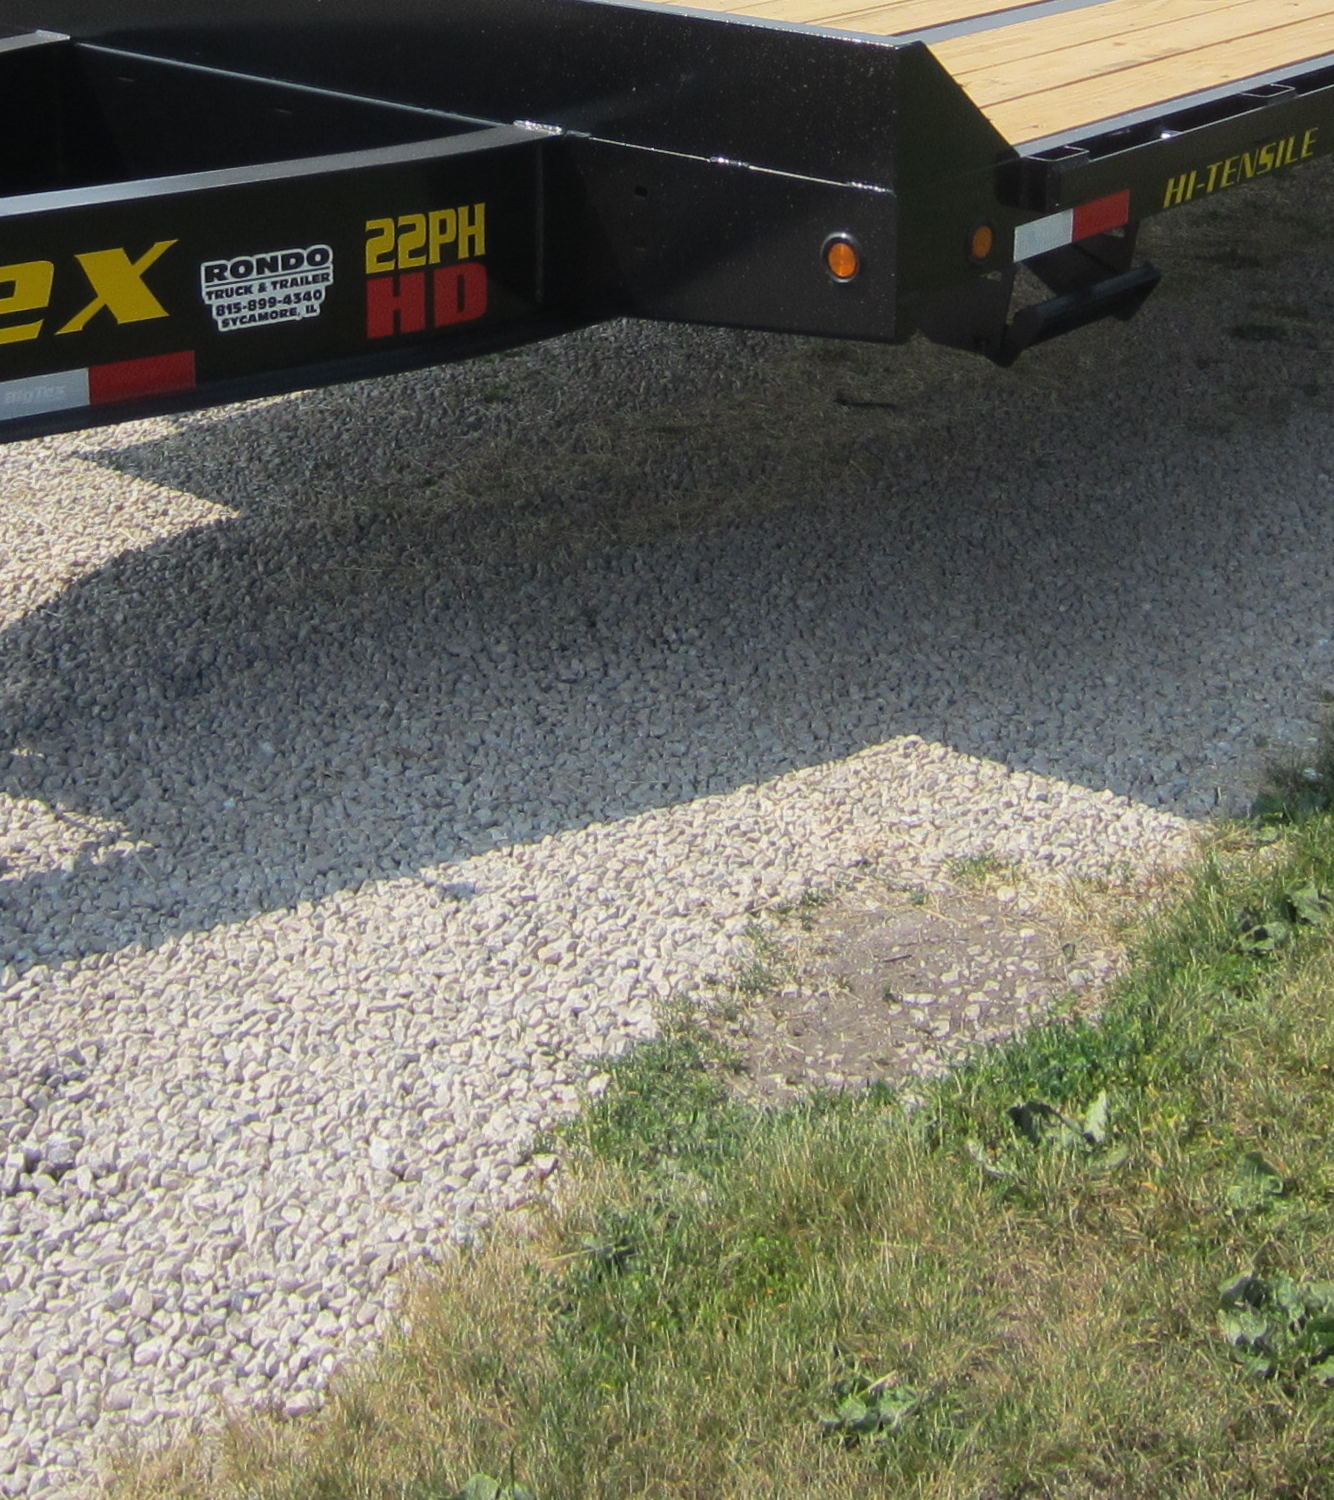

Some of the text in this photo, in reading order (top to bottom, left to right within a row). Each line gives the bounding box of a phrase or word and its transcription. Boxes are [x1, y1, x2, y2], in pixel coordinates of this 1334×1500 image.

[1163, 127, 1319, 208] HI-TENSILE
[365, 202, 486, 274] 22PH
[205, 247, 330, 283] RONDO
[207, 272, 331, 301] TRUCK & TRAILER
[216, 289, 323, 317] 815-899-4340
[367, 262, 488, 339] HD
[306, 304, 317, 314] IL
